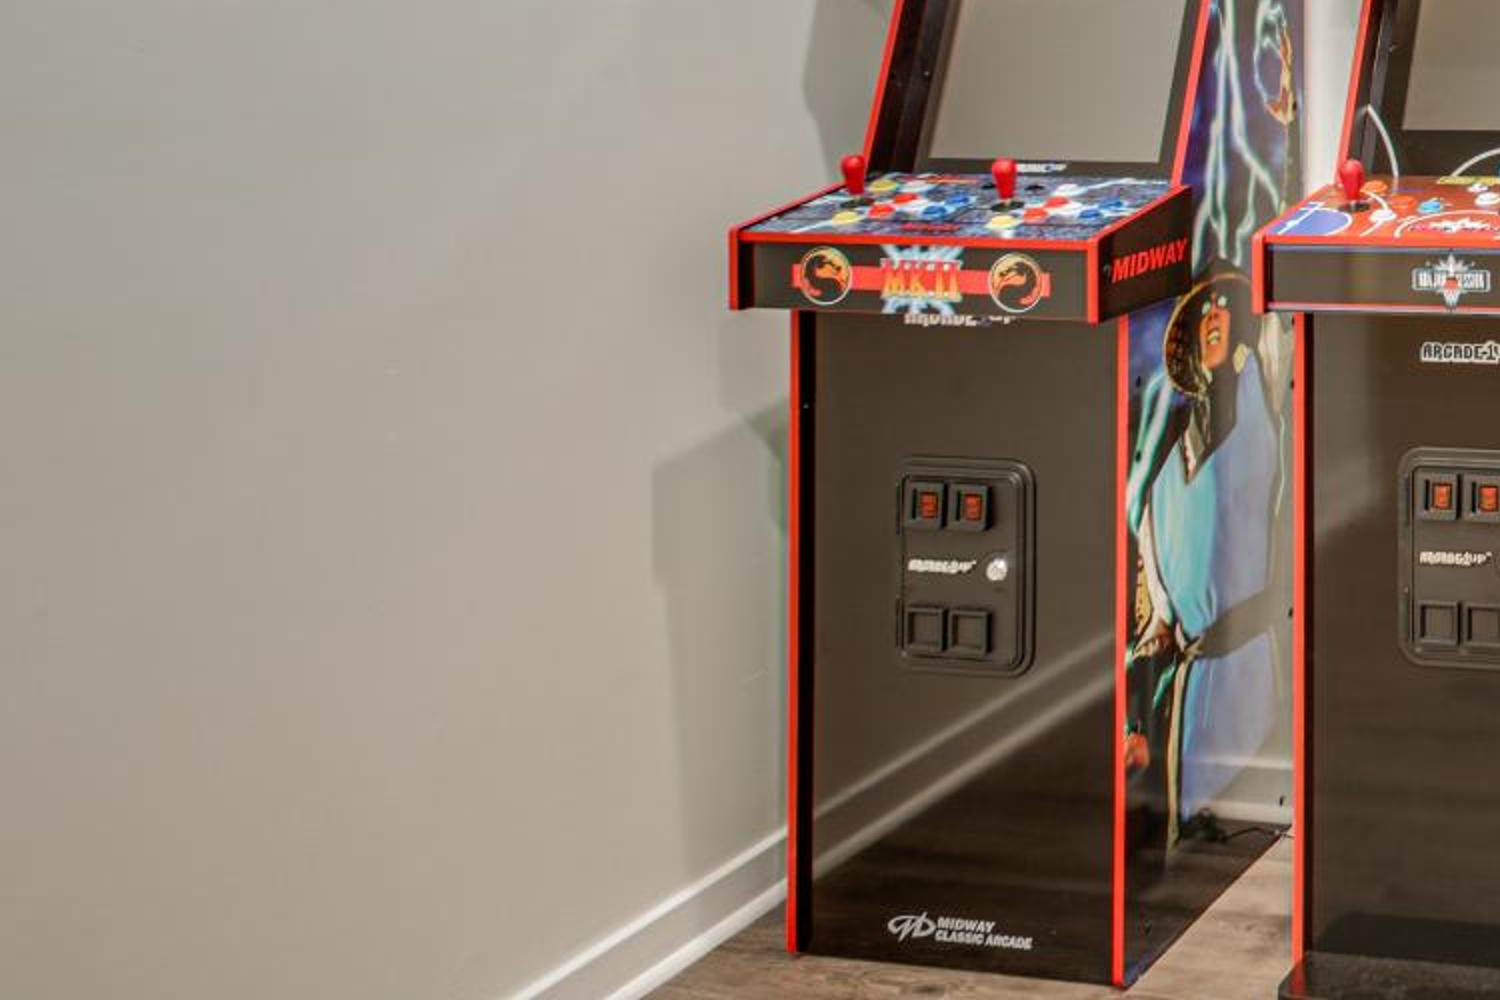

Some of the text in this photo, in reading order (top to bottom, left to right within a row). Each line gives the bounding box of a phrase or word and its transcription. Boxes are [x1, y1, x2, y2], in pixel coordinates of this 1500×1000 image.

[1111, 237, 1187, 284] MIDWAY
[937, 916, 996, 933] MIDWAY
[935, 928, 1034, 950] CLASSIC ARCADE
